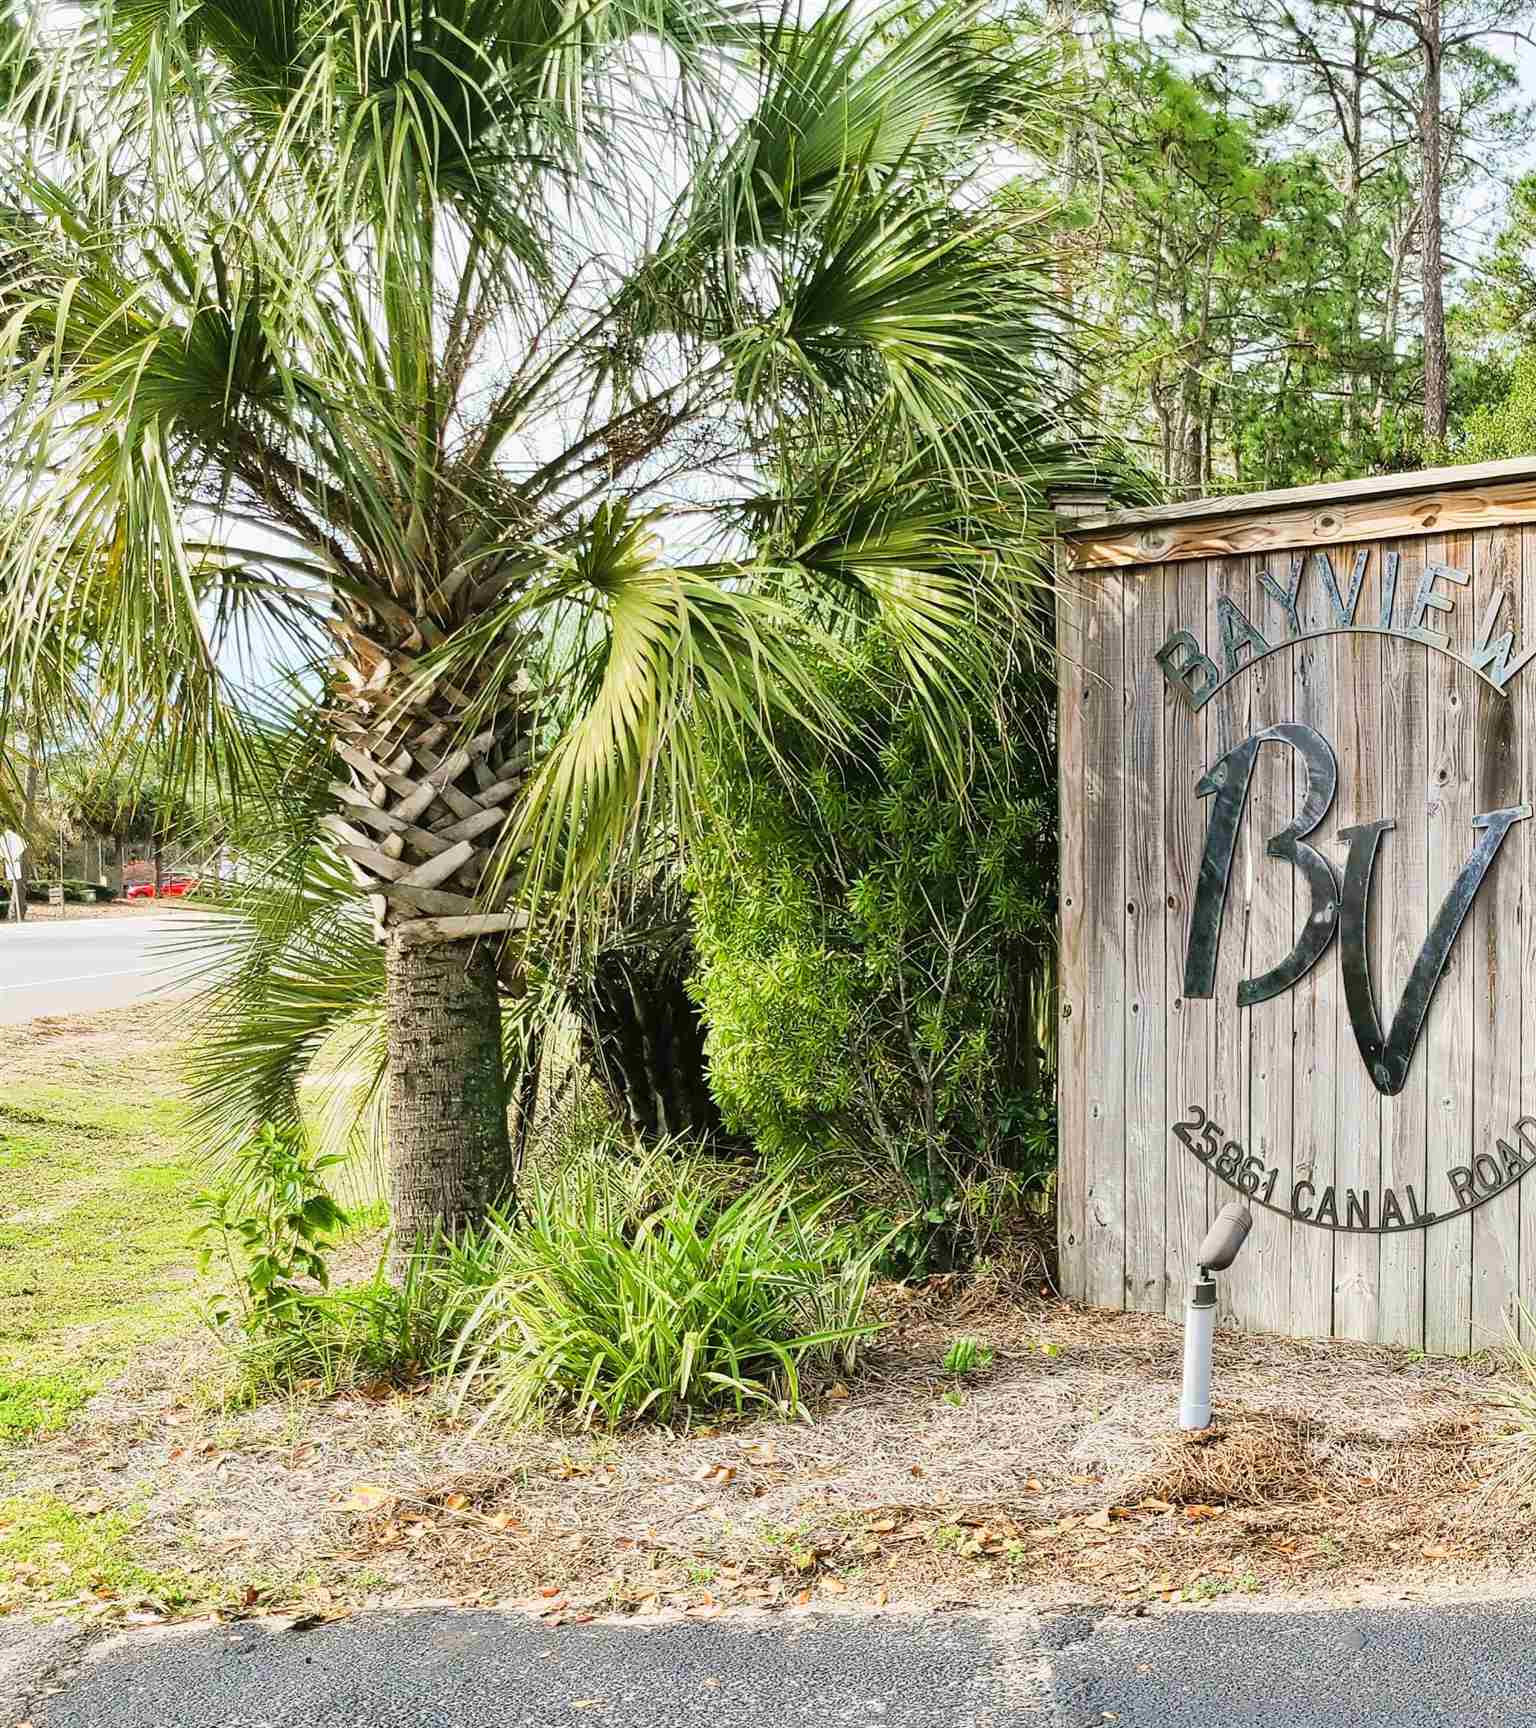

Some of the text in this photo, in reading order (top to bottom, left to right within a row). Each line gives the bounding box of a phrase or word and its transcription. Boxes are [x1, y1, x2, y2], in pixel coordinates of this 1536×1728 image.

[1184, 721, 1534, 1096] BV
[1172, 1105, 1280, 1208] 25861
[1289, 1180, 1436, 1230] CANAL
